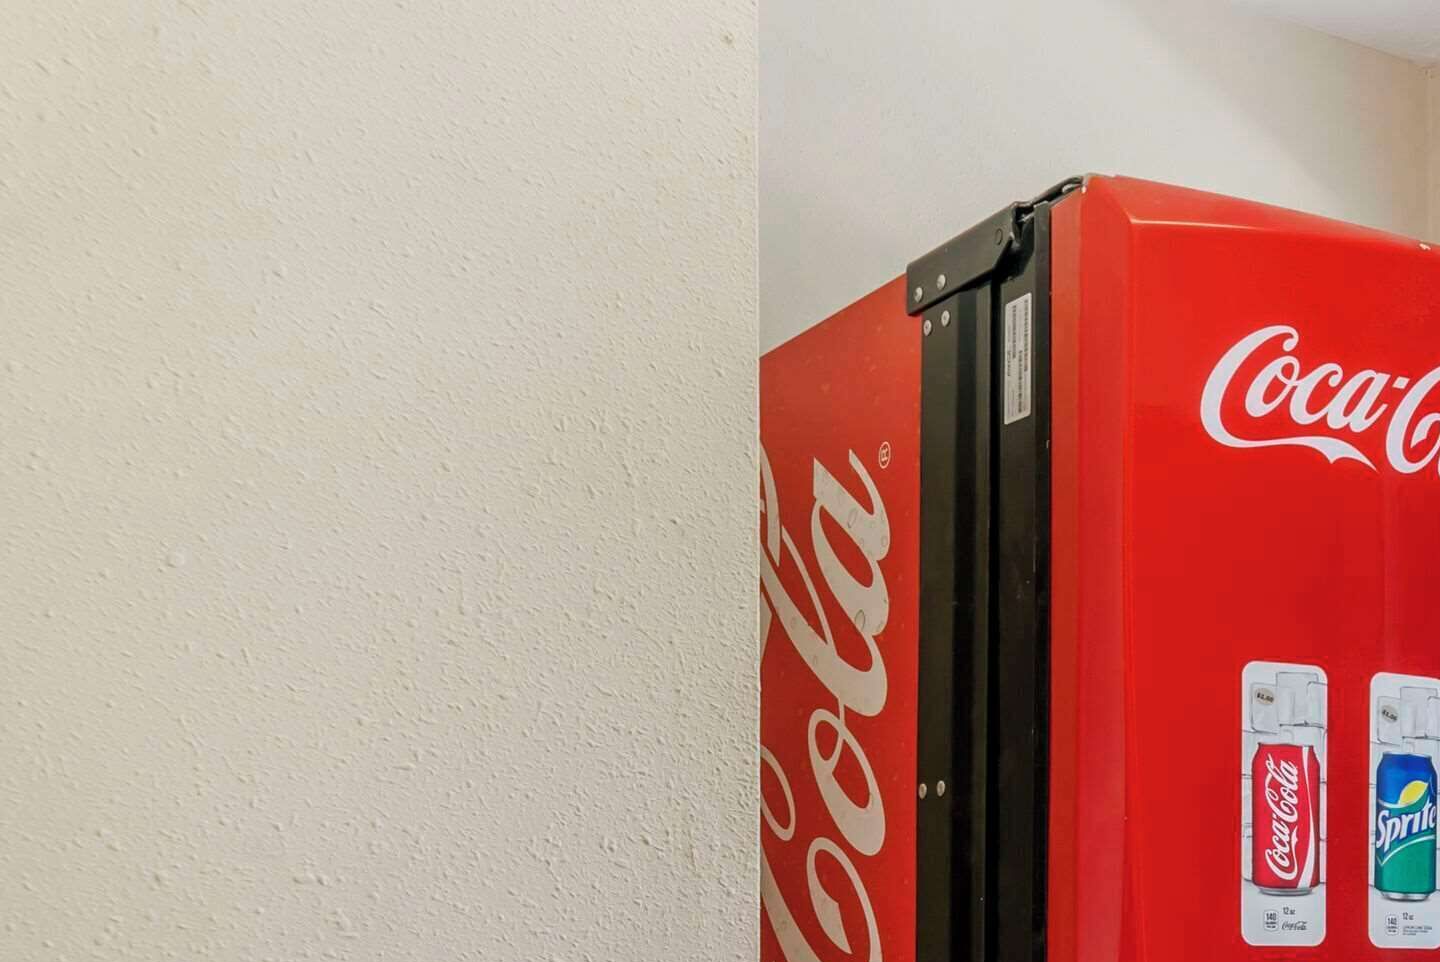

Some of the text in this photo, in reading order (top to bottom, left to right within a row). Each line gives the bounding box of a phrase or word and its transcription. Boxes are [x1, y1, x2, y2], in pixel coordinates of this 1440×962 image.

[1265, 753, 1298, 881] Coca-Cola
[1376, 796, 1437, 853] Sprite
[1266, 912, 1277, 921] 140
